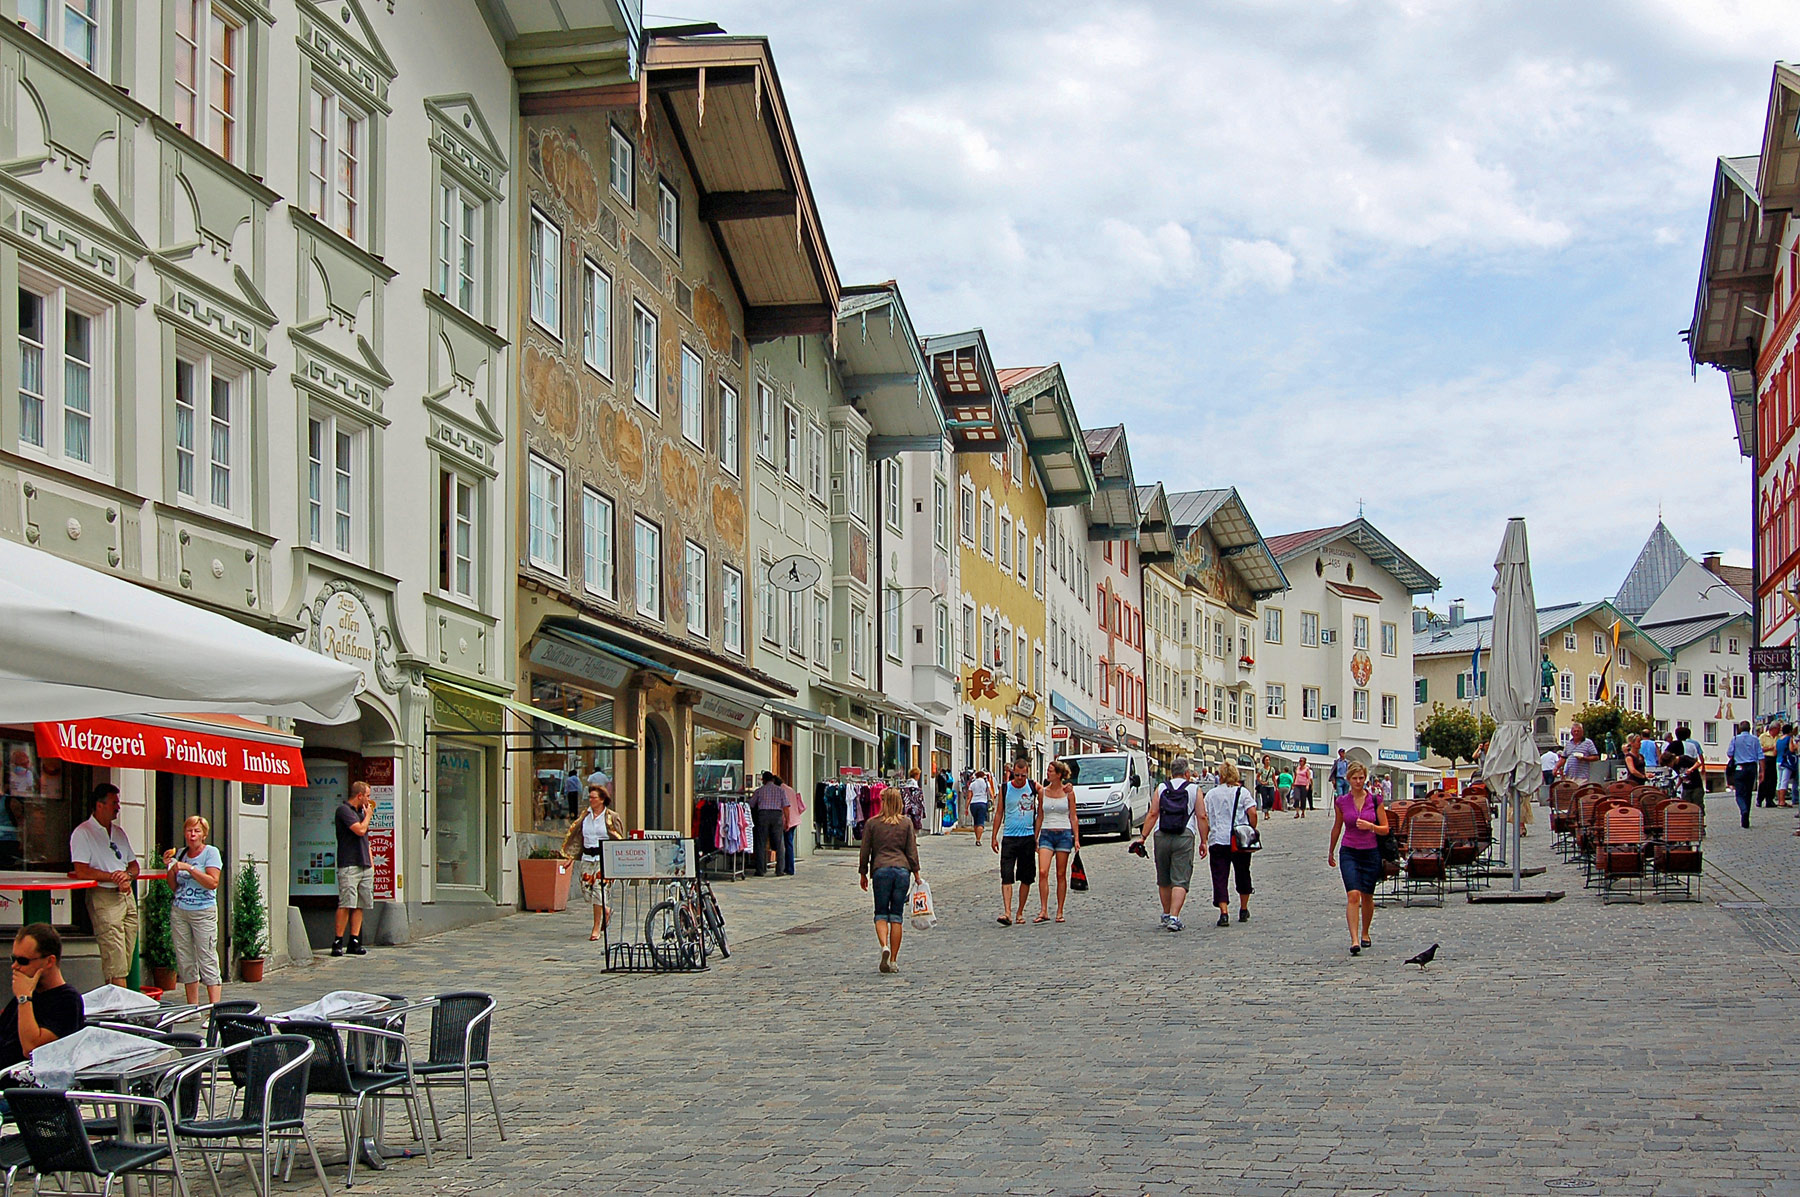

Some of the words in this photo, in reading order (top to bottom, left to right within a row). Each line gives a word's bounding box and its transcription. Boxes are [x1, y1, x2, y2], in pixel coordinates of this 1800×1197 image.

[337, 594, 357, 612] Zum
[324, 626, 372, 662] Rathhaus
[1753, 653, 1788, 666] FRISEUR
[57, 723, 146, 759] Metzgerei
[163, 736, 227, 767] Feinkost
[242, 749, 291, 775] Imbiss
[438, 755, 470, 770] AVIA
[368, 838, 393, 849] ESTERN
[625, 848, 647, 856] SÜDEN
